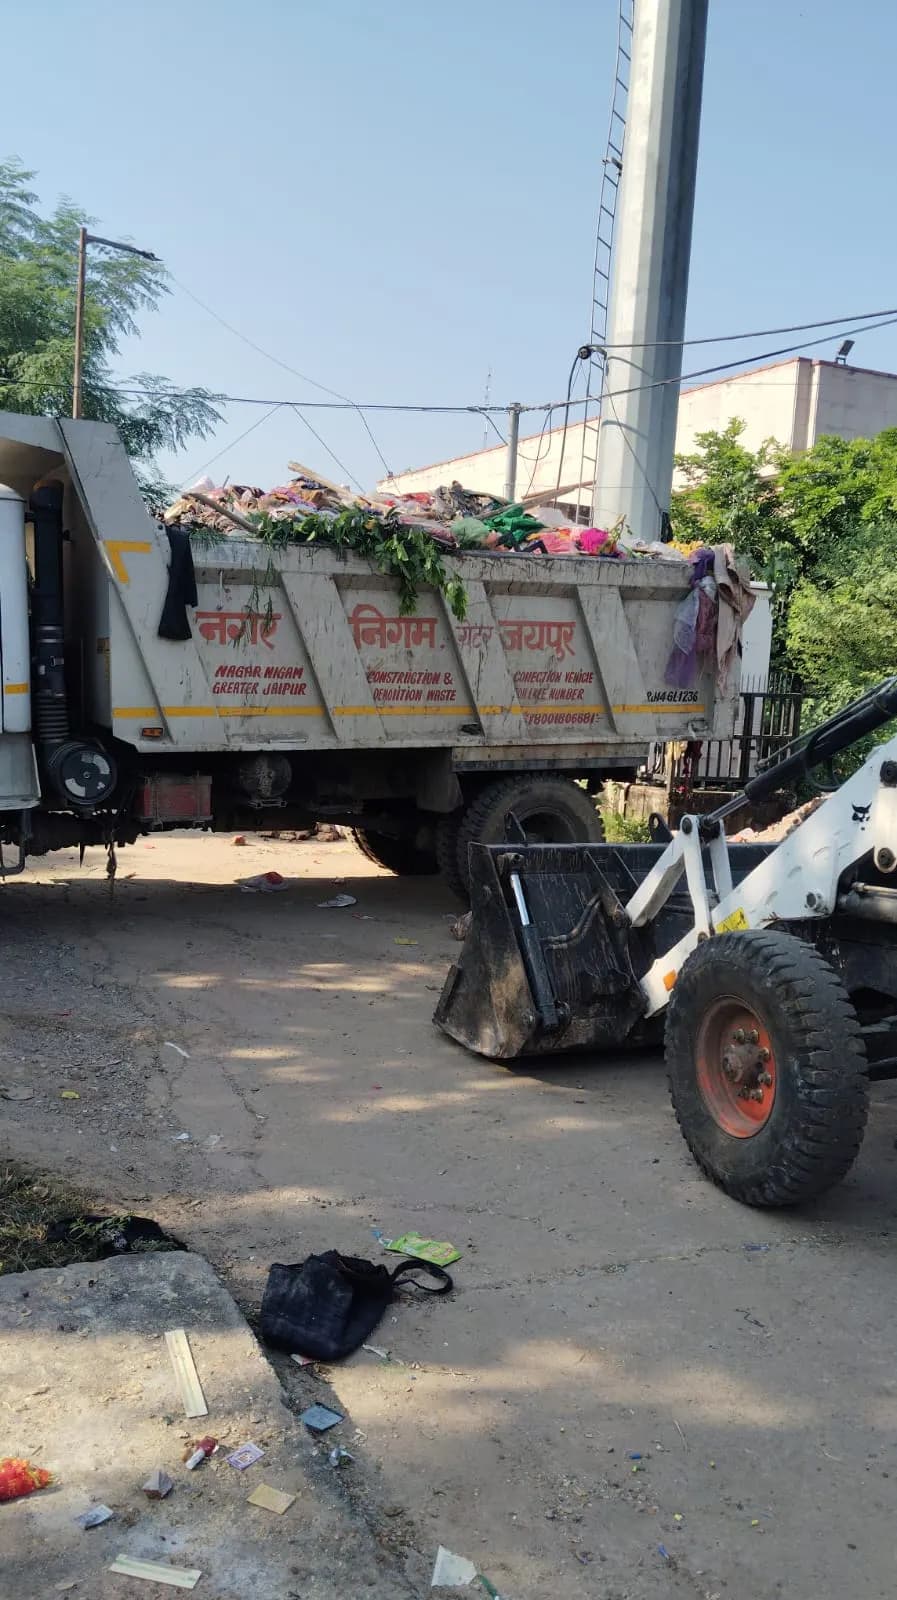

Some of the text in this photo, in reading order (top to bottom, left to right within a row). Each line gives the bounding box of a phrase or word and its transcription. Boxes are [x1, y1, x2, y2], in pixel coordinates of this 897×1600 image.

[195, 611, 282, 650] नगर
[347, 603, 438, 651] निगम
[498, 620, 576, 662] जयपुर
[214, 665, 304, 679] NAGAR NIGAM
[443, 672, 453, 685] &
[212, 681, 307, 696] GREATER JAIPUR
[427, 689, 456, 701] WASTE
